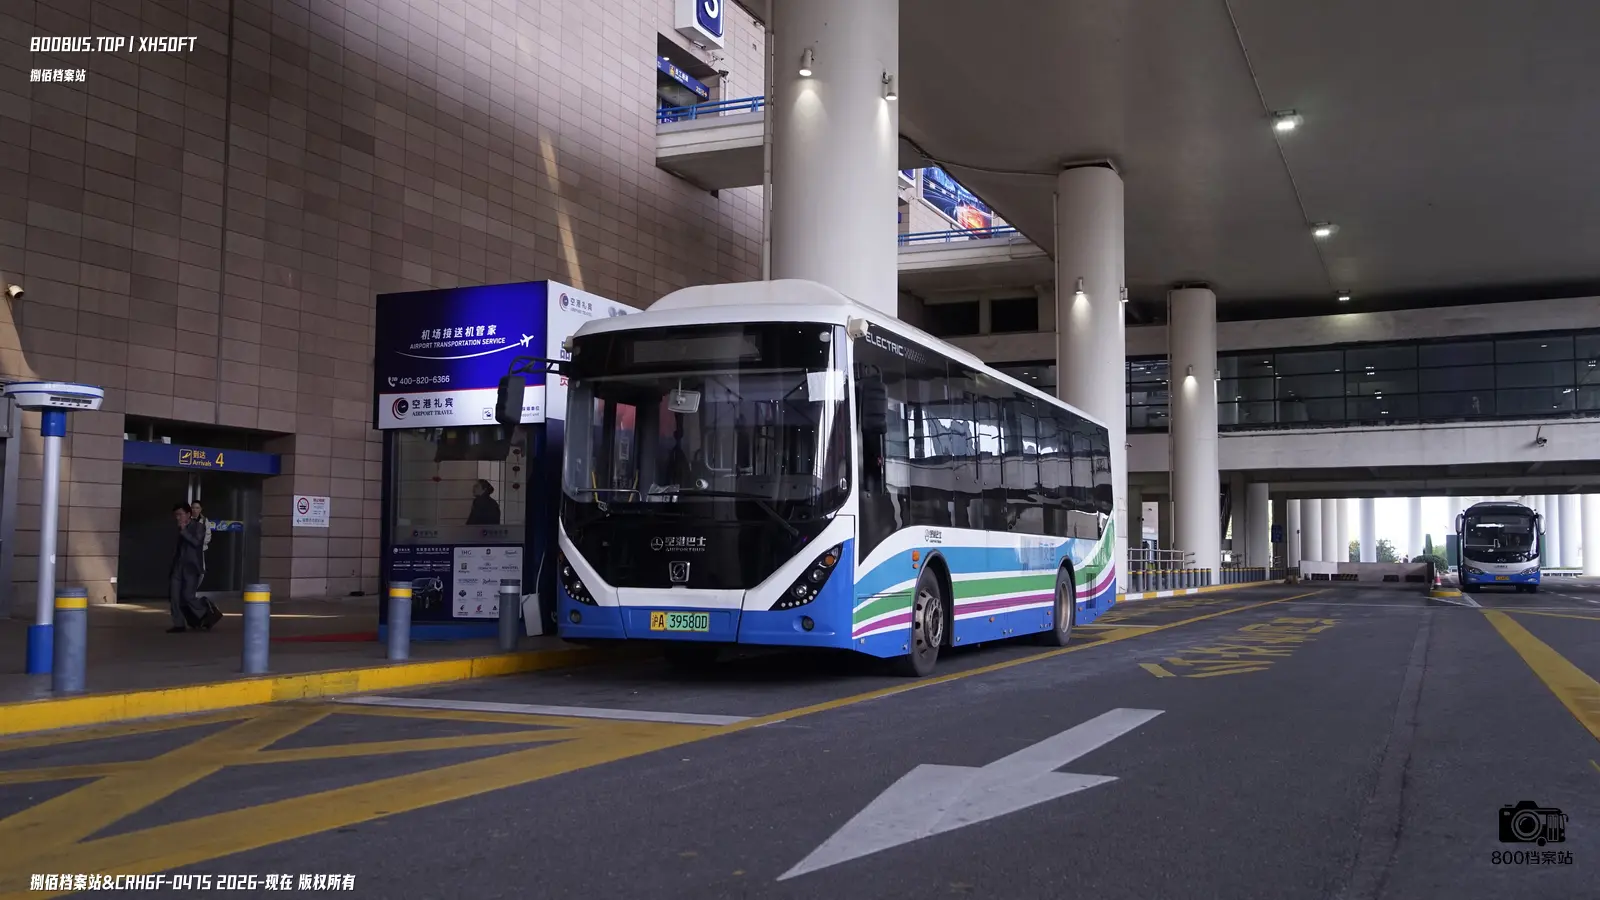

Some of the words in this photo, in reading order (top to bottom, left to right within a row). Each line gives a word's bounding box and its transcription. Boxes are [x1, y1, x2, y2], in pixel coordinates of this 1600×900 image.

[421, 324, 497, 340] 机场接送机管家
[410, 342, 433, 350] AIRPORT
[433, 338, 481, 348] TRANSPORTATION
[482, 337, 506, 345] SERVICE
[865, 331, 904, 357] ELECTRIC
[399, 375, 451, 385] 400-820-6366
[412, 397, 454, 409] 空港礼宾
[193, 450, 206, 459] 到达
[215, 452, 225, 468] 4
[192, 459, 212, 467] Arrivals
[651, 614, 665, 629] 沪A
[669, 614, 708, 629] 39580D
